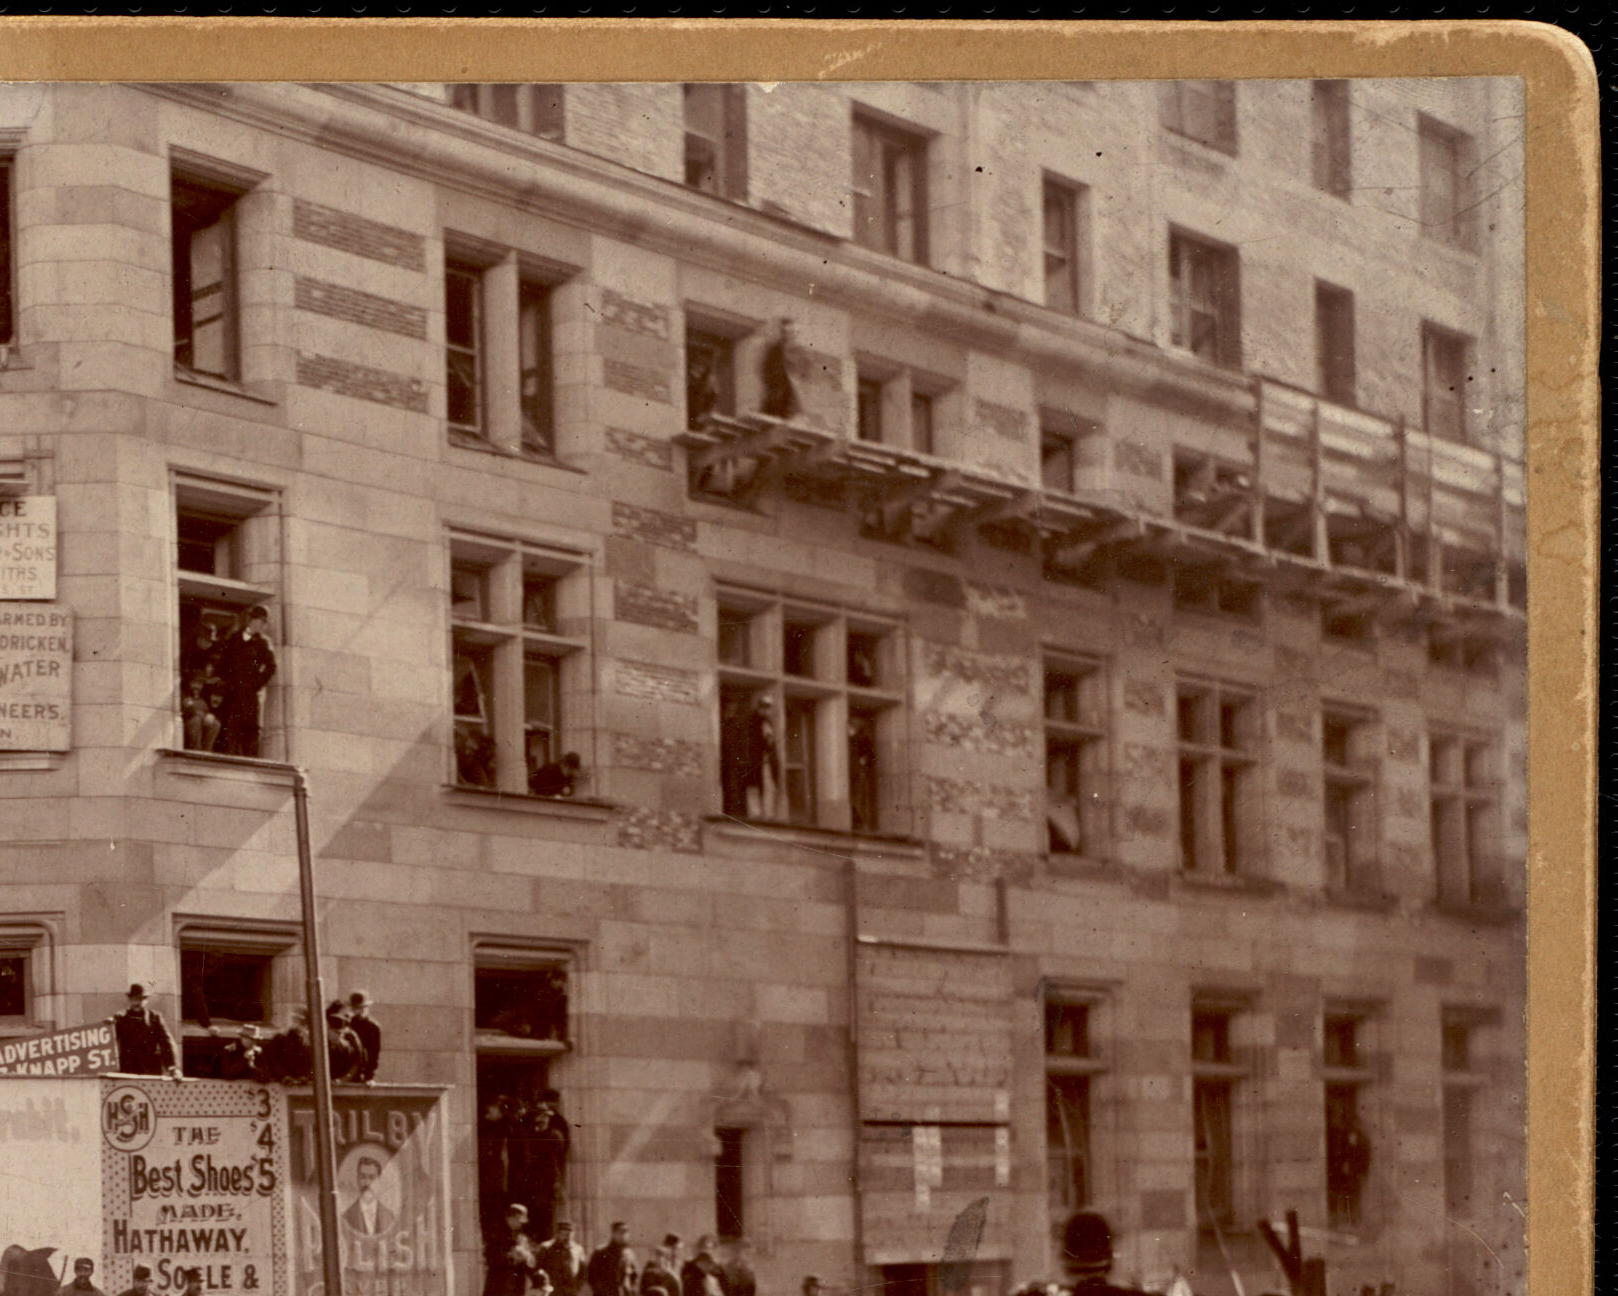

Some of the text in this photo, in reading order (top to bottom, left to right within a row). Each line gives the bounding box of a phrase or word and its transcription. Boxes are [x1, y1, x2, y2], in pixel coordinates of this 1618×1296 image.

[12, 541, 56, 562] SONS
[48, 613, 69, 628] BY
[86, 1048, 117, 1070] ST.
[172, 1125, 224, 1147] THE
[292, 1107, 440, 1180] TRILBY
[131, 1153, 184, 1199] Best
[186, 1153, 254, 1199] Shoes
[298, 1193, 440, 1273] PLISH
[156, 1257, 261, 1295] SOLE &
